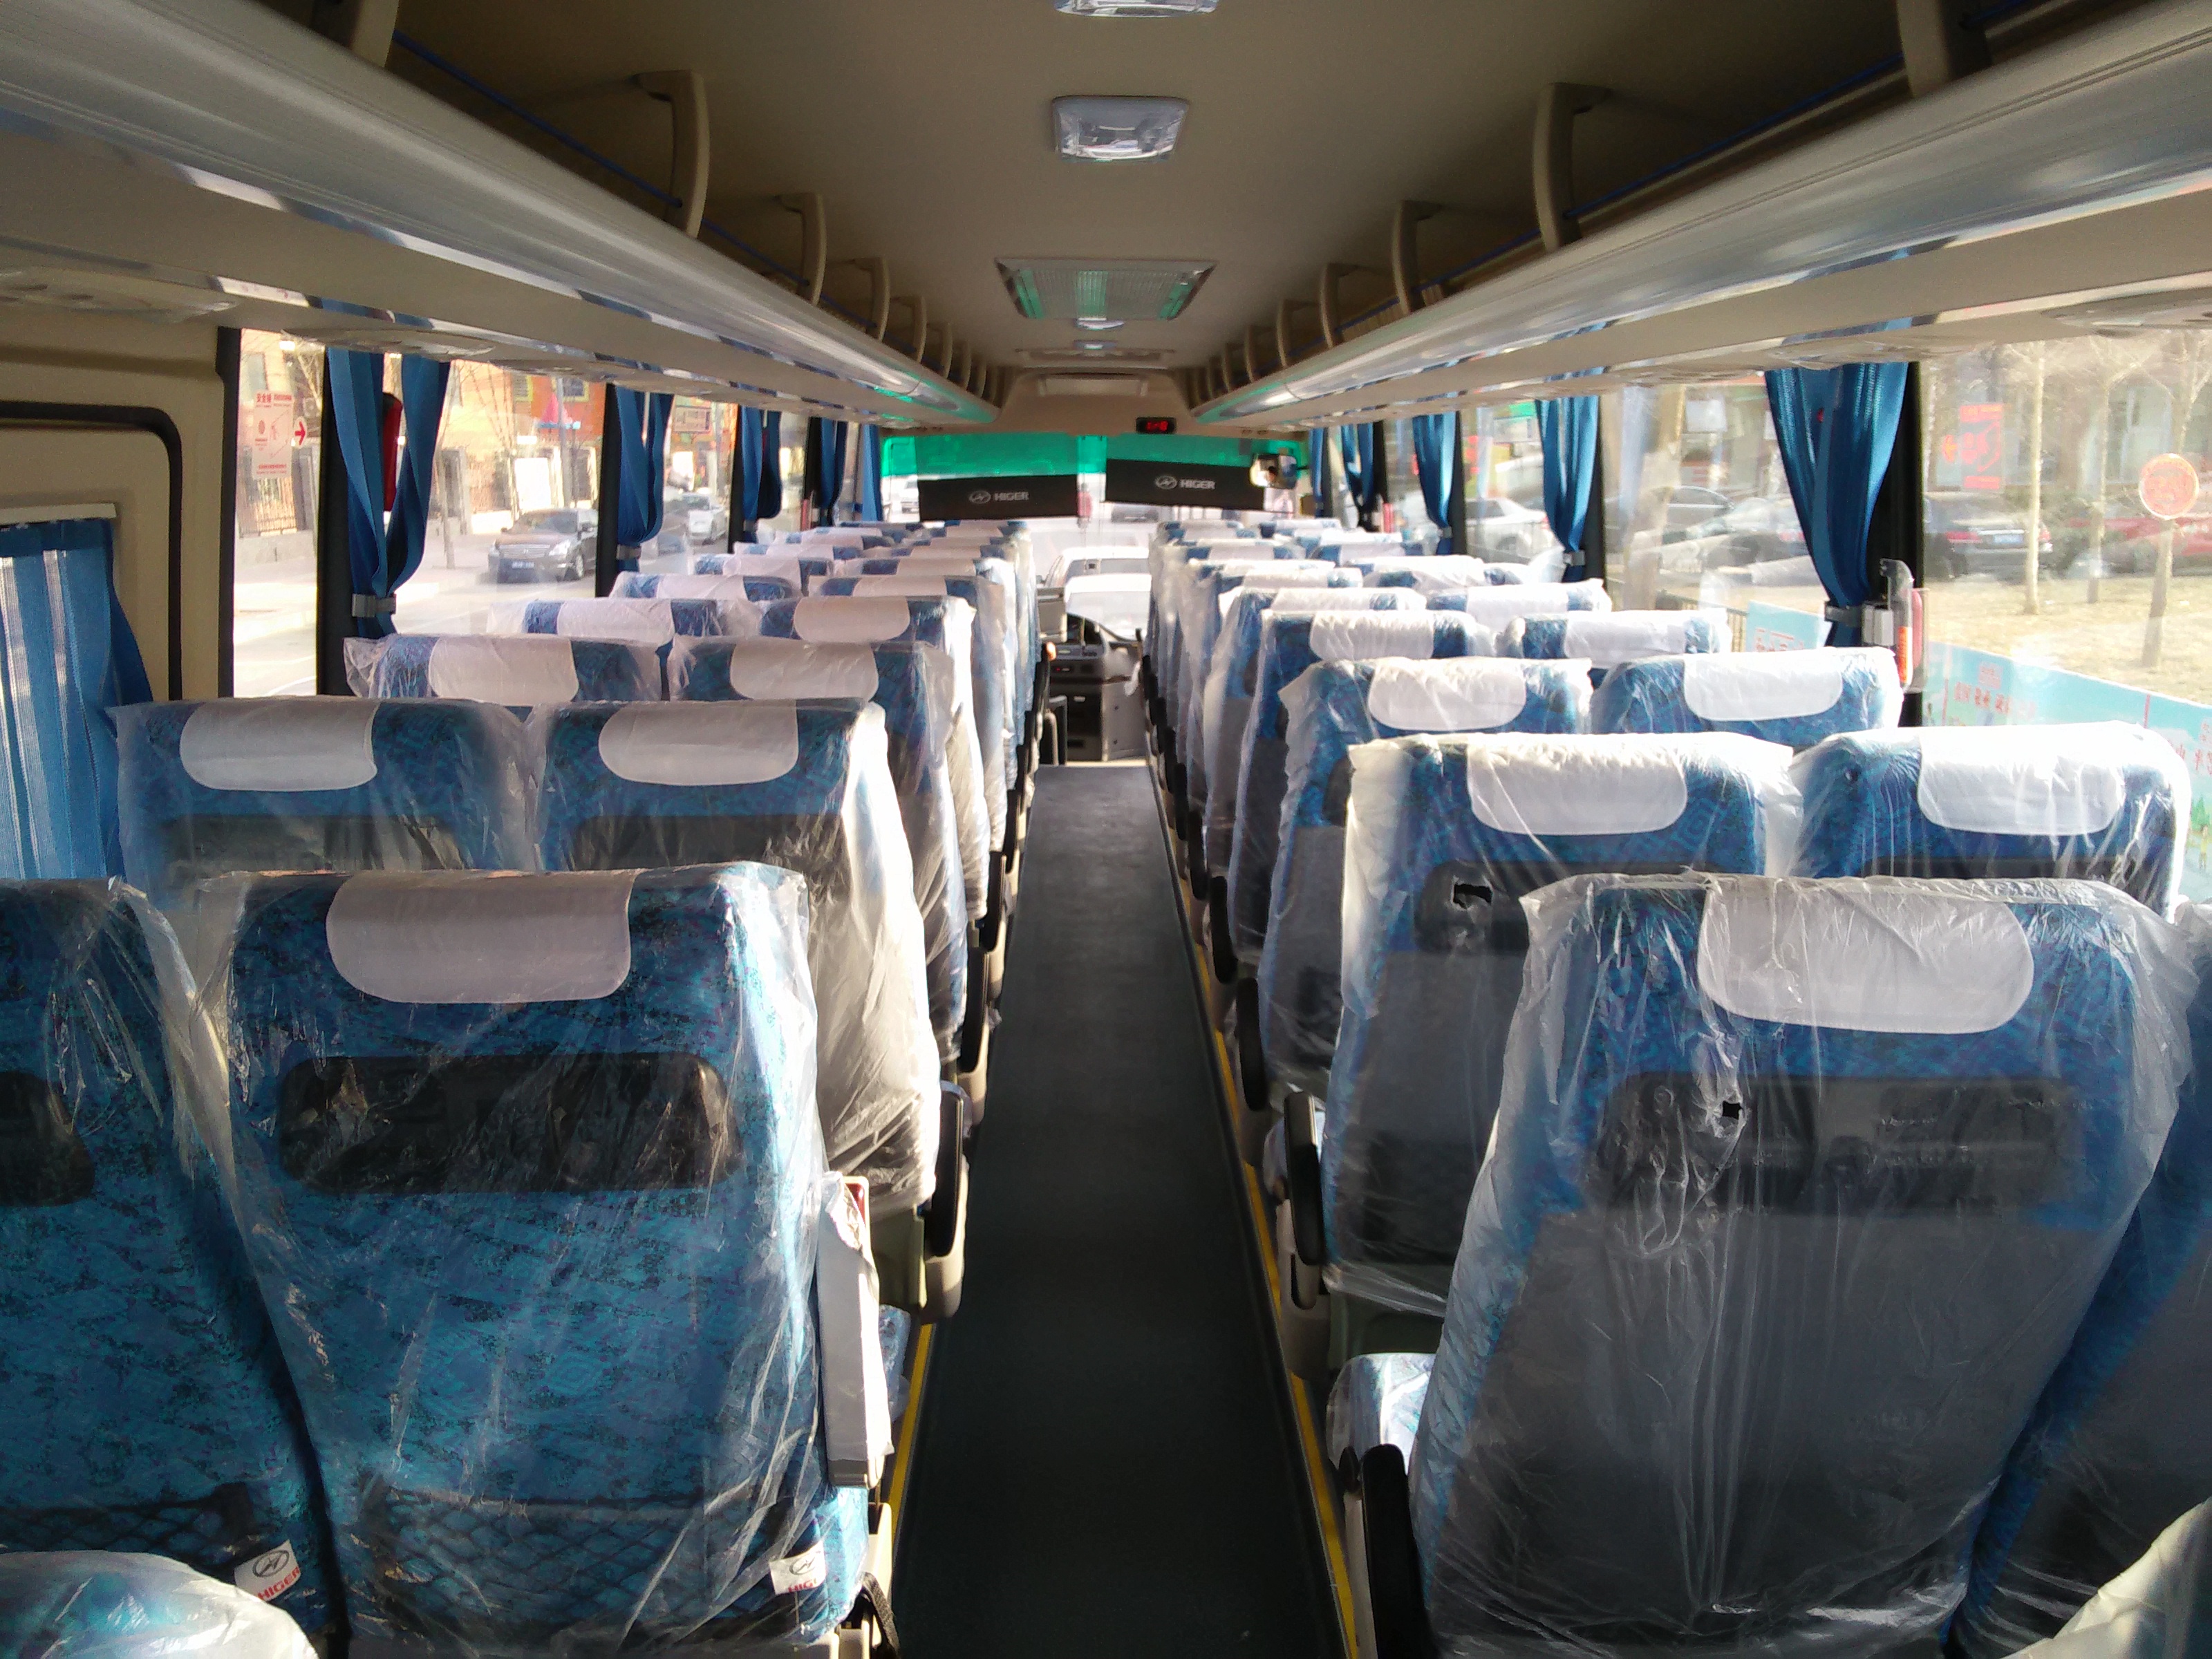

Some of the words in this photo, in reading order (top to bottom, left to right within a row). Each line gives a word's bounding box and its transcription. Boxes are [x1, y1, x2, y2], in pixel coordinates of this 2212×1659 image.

[1180, 479, 1216, 489] HIGER
[994, 491, 1029, 501] HIGER
[258, 1566, 301, 1601] HIGER
